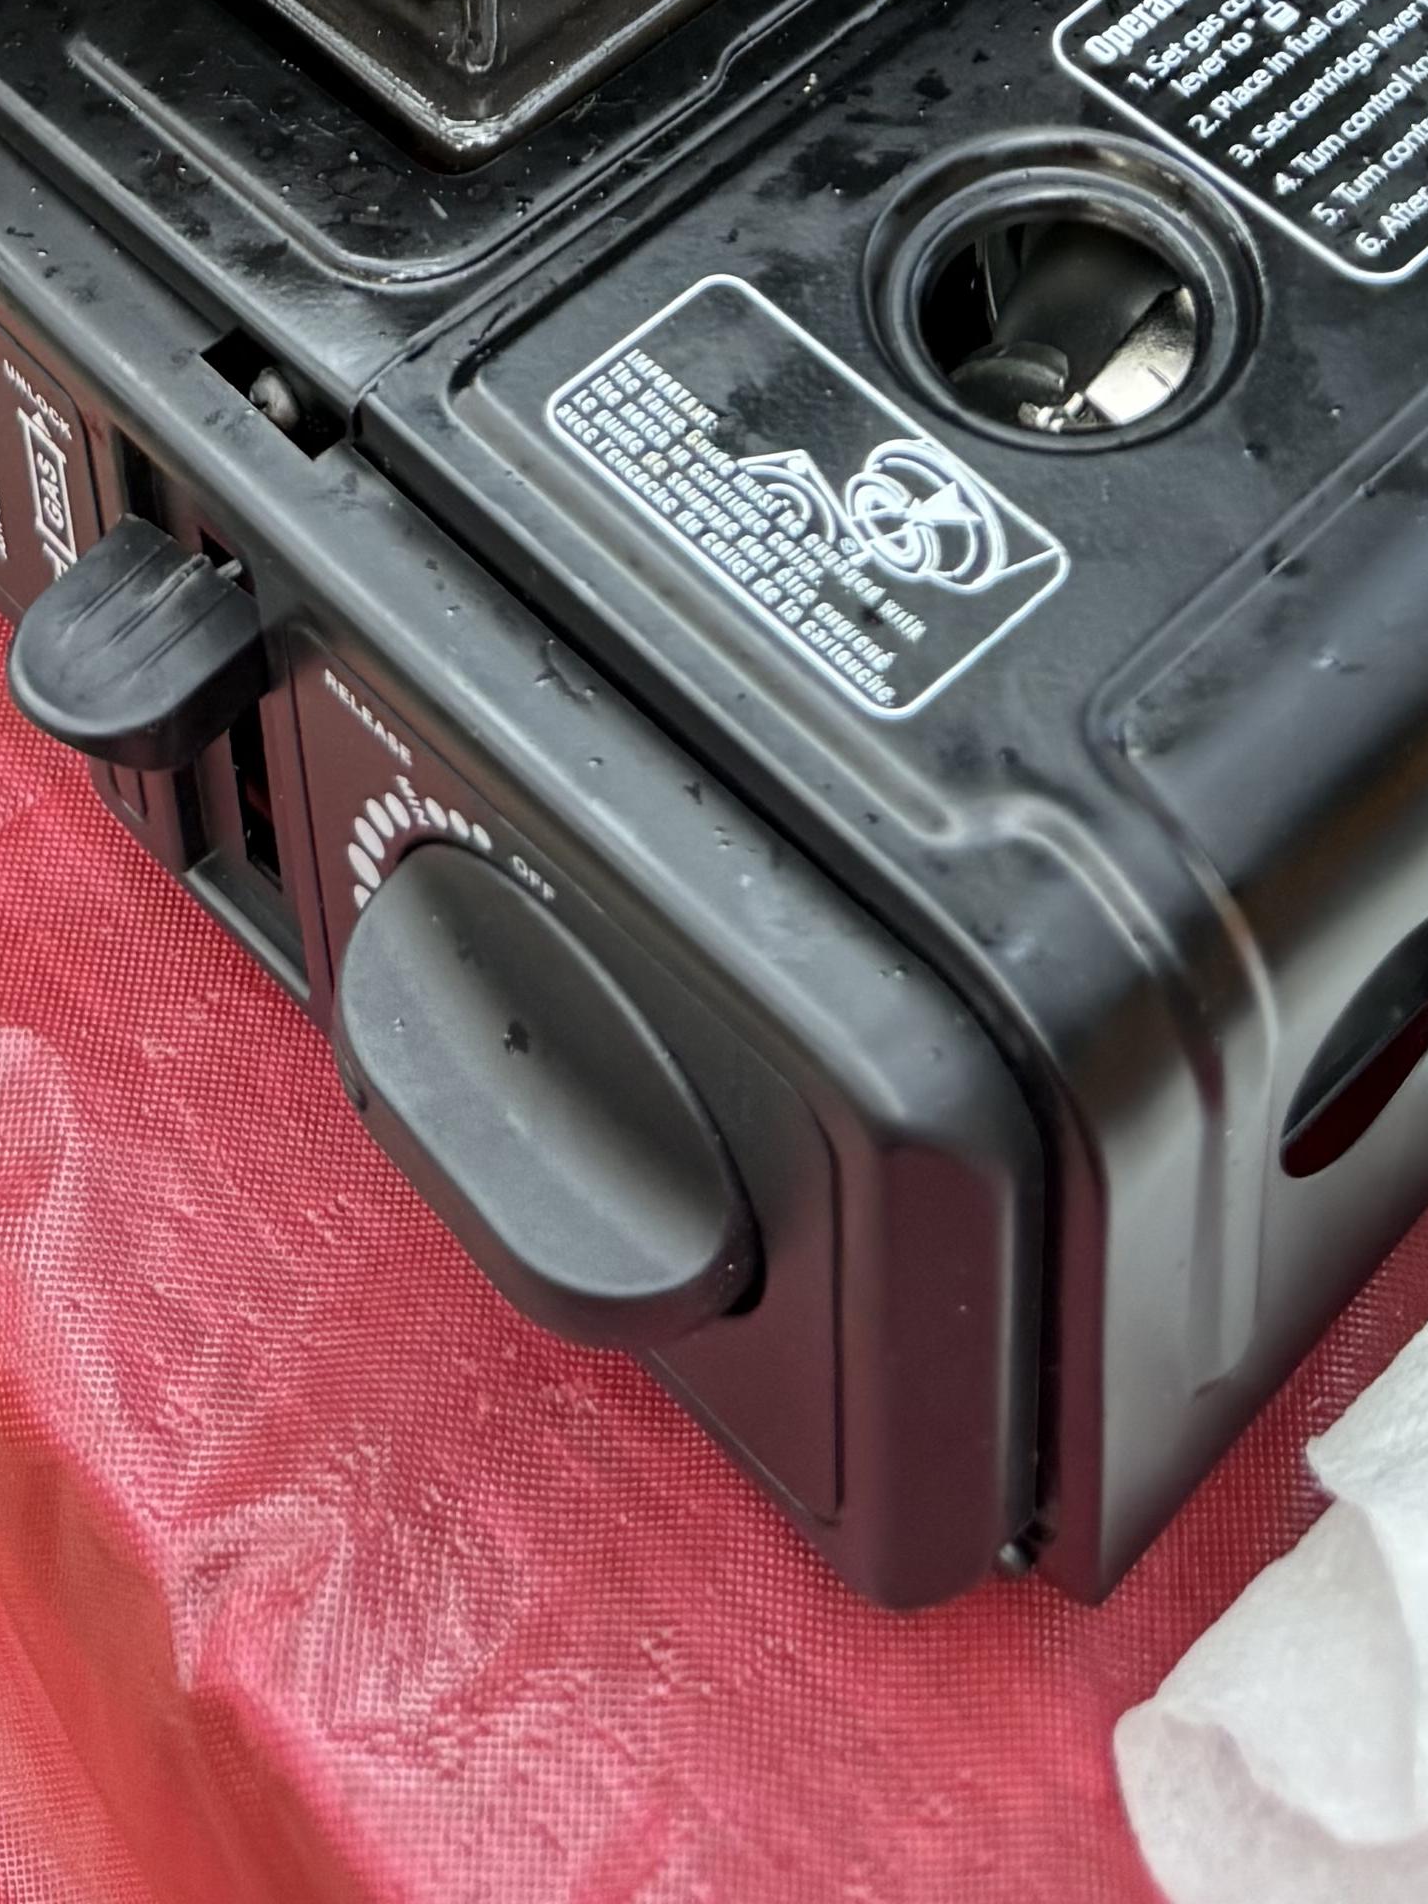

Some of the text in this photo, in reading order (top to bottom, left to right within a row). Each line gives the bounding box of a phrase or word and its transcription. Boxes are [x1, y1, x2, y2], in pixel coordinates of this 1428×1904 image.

[1127, 72, 1156, 90] 1.
[1145, 42, 1191, 78] Set
[1183, 13, 1226, 54] gas
[1169, 49, 1227, 98] lever
[1187, 114, 1222, 139] 2.
[1209, 68, 1275, 119] Place
[1262, 51, 1296, 75] in
[1283, 16, 1332, 57] fuel
[1228, 143, 1263, 167] 3.
[1250, 111, 1297, 148] Set
[1289, 42, 1380, 119] cartridge
[1367, 2, 1423, 49] lever
[1275, 172, 1303, 195] 4.
[1289, 134, 1347, 175] Turn
[1340, 72, 1414, 140] control
[1310, 202, 1346, 227] 5.
[1330, 157, 1389, 206] Turn
[1355, 231, 1388, 257] 6.
[3, 358, 73, 441] UNLOCK
[589, 375, 624, 407] the
[618, 402, 672, 449] notch
[667, 444, 692, 467] in
[607, 361, 642, 394] The
[637, 388, 688, 435] Valve
[682, 429, 744, 477] Guide
[592, 409, 645, 455] guide
[640, 451, 669, 477] de
[35, 451, 66, 532] GAS
[552, 403, 600, 444] avec
[674, 510, 705, 536] du
[750, 577, 782, 605] de
[776, 598, 804, 624] la
[324, 667, 413, 767] RELEASE
[512, 854, 556, 902] OFF
